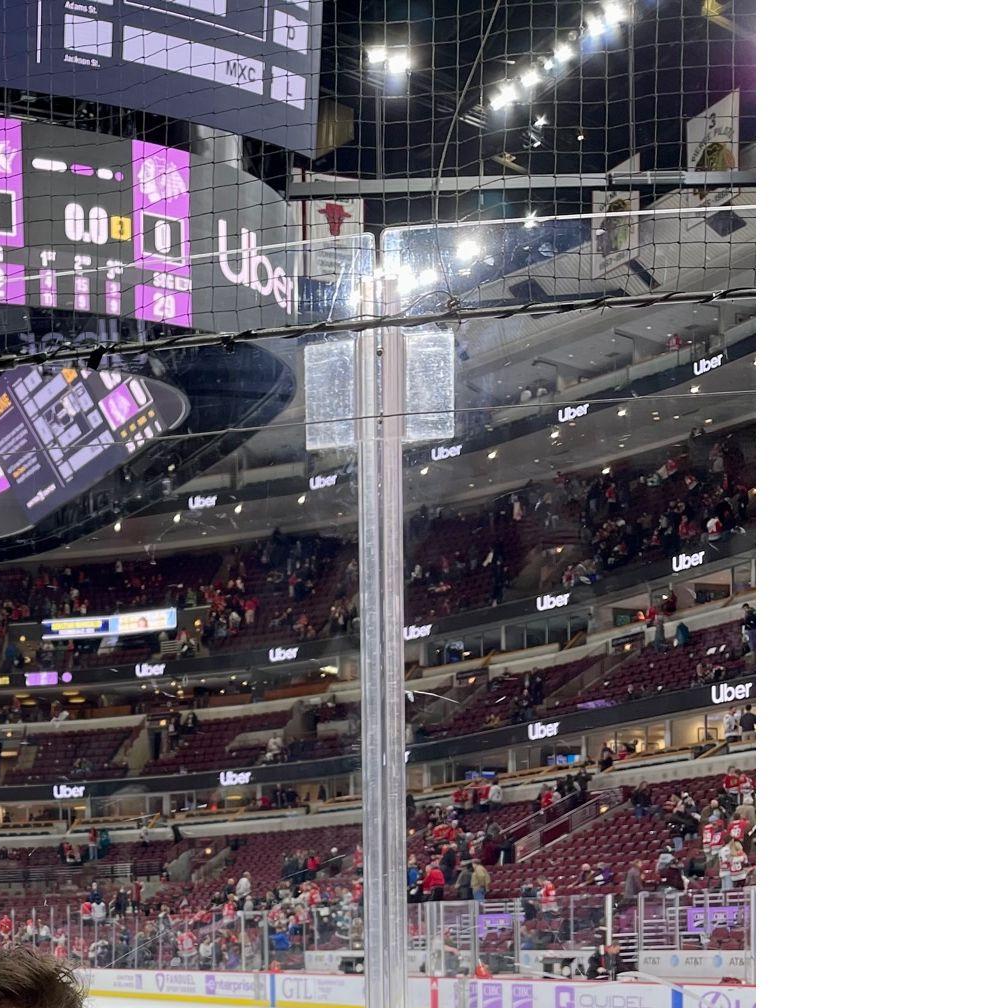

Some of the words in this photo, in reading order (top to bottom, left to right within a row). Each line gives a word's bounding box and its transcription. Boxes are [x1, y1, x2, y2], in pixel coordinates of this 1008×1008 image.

[64, 1, 88, 12] Adams
[64, 54, 90, 66] Jackson
[225, 60, 256, 83] MXC
[65, 202, 108, 245] 0.0
[155, 220, 171, 254] 0
[153, 292, 176, 319] 29
[693, 353, 724, 376] Uber
[558, 403, 590, 423] Uber
[430, 443, 463, 461] Uber
[309, 474, 339, 490] Uber
[188, 495, 218, 510] Uber
[672, 550, 705, 572] Uber
[536, 593, 570, 611] Uber
[403, 622, 433, 641] Uber
[268, 647, 299, 662] Uber
[135, 663, 166, 678] Uber
[711, 682, 753, 704] Uber
[527, 721, 561, 741] Uber
[219, 770, 252, 787] Uber
[53, 784, 86, 799] Uber
[643, 957, 661, 966] AT&T
[685, 957, 703, 966] AT&T
[206, 977, 255, 993] enterpris
[282, 977, 312, 1000] GTL
